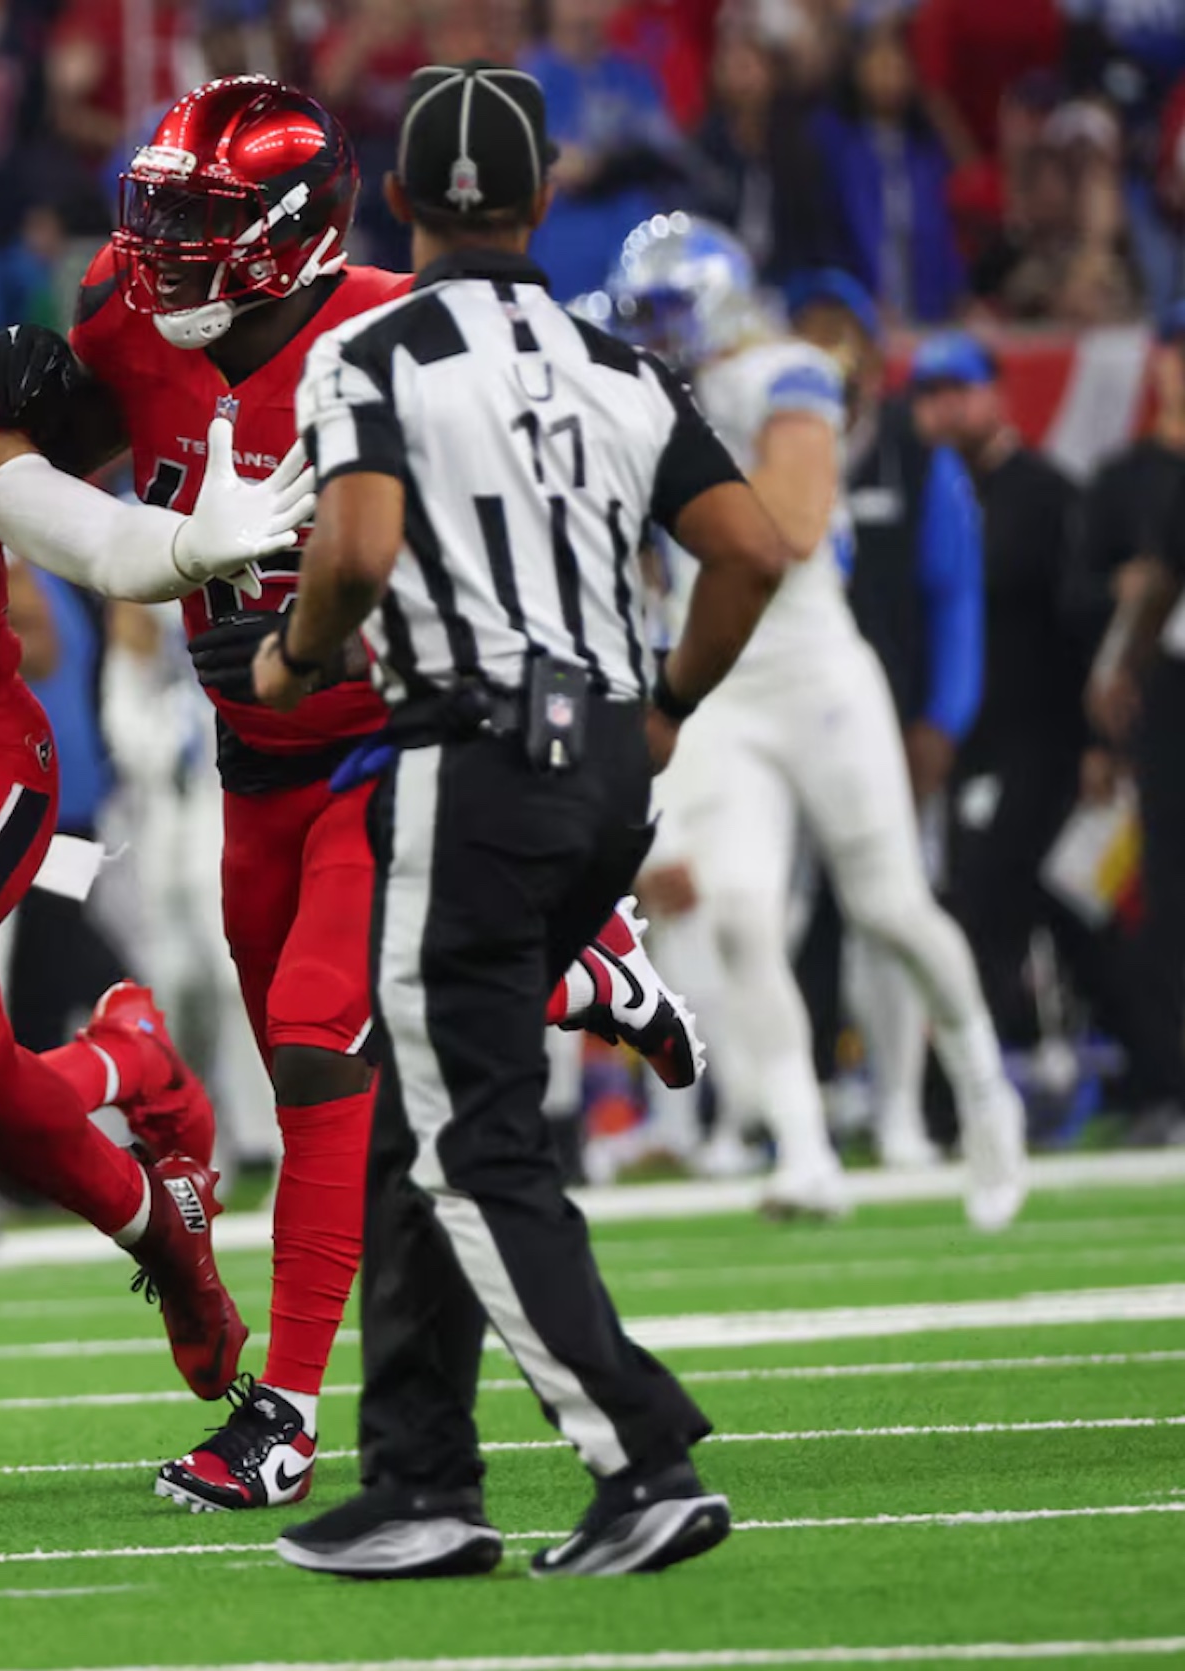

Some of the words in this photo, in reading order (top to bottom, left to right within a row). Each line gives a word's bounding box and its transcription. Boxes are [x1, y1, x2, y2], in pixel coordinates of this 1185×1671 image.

[513, 361, 552, 402] U
[176, 436, 279, 468] TEANS
[165, 1180, 206, 1229] NIKE
